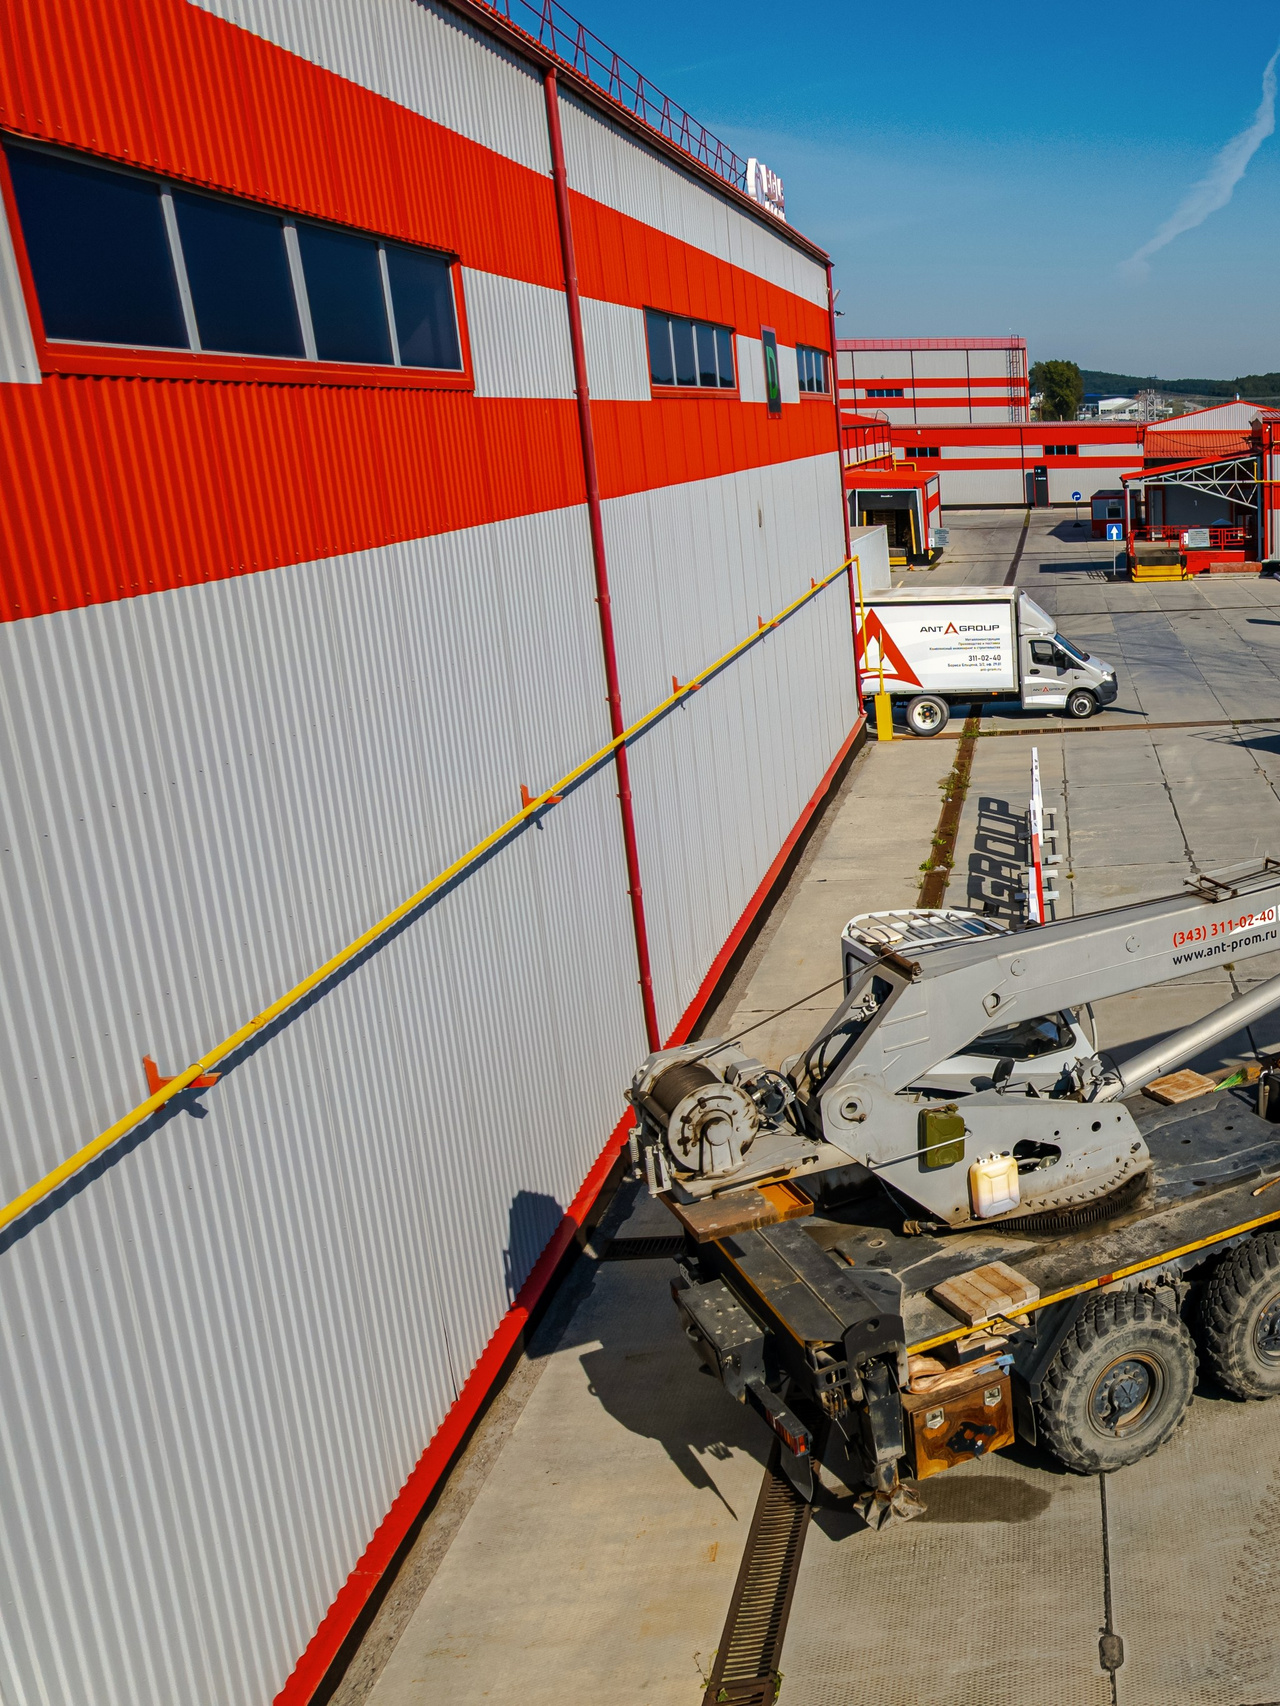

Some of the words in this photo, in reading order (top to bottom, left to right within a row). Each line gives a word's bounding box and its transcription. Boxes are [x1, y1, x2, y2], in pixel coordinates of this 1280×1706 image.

[765, 345, 778, 399] D
[959, 624, 1000, 632] GROUP
[1172, 929, 1277, 965] www.ant-prom.ru
[1173, 926, 1207, 948] (343)
[1211, 909, 1274, 936] 311-02-40
